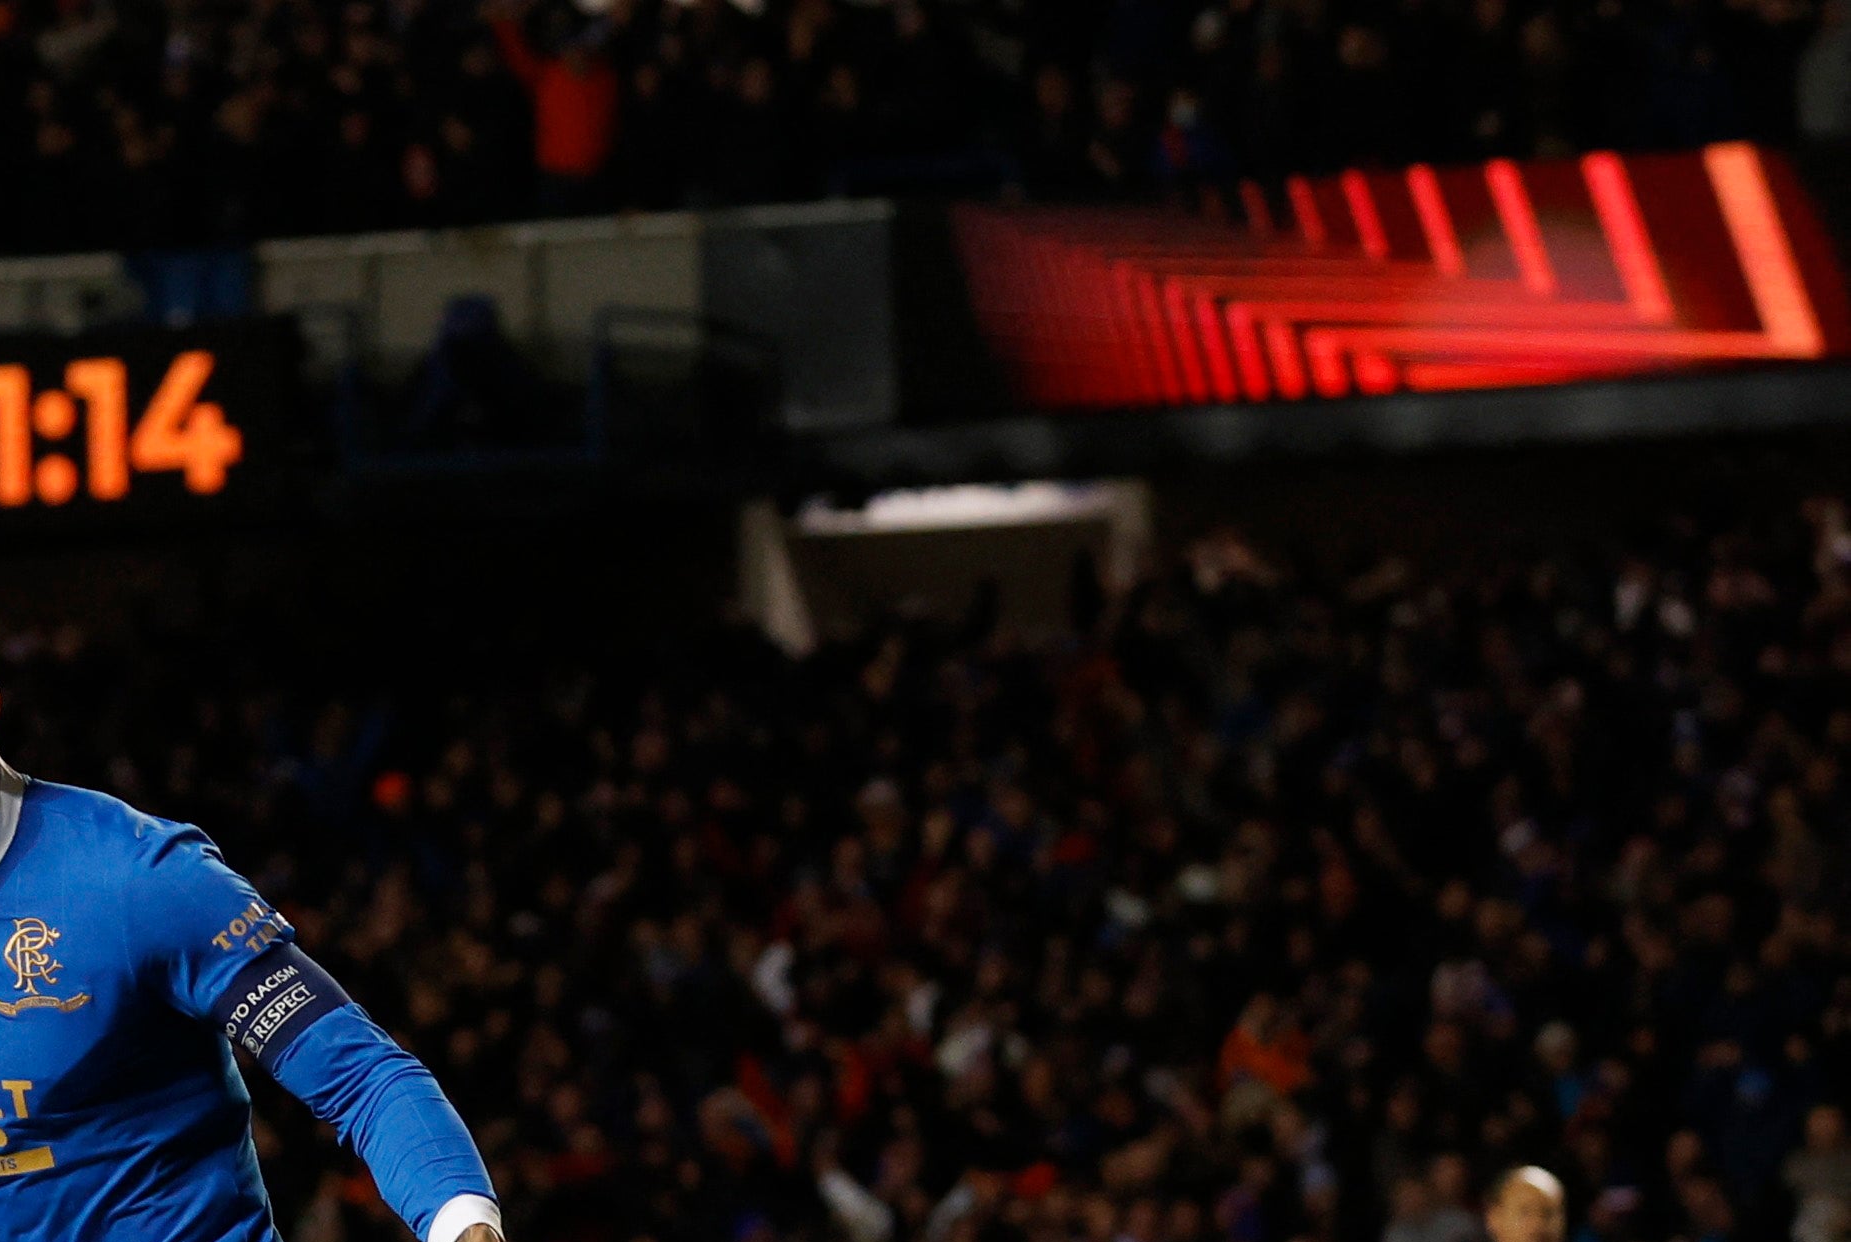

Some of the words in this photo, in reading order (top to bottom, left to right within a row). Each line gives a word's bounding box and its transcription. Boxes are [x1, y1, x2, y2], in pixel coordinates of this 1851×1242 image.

[230, 1003, 250, 1024] TO
[246, 965, 299, 1006] RACISM
[253, 984, 311, 1039] RESPECT
